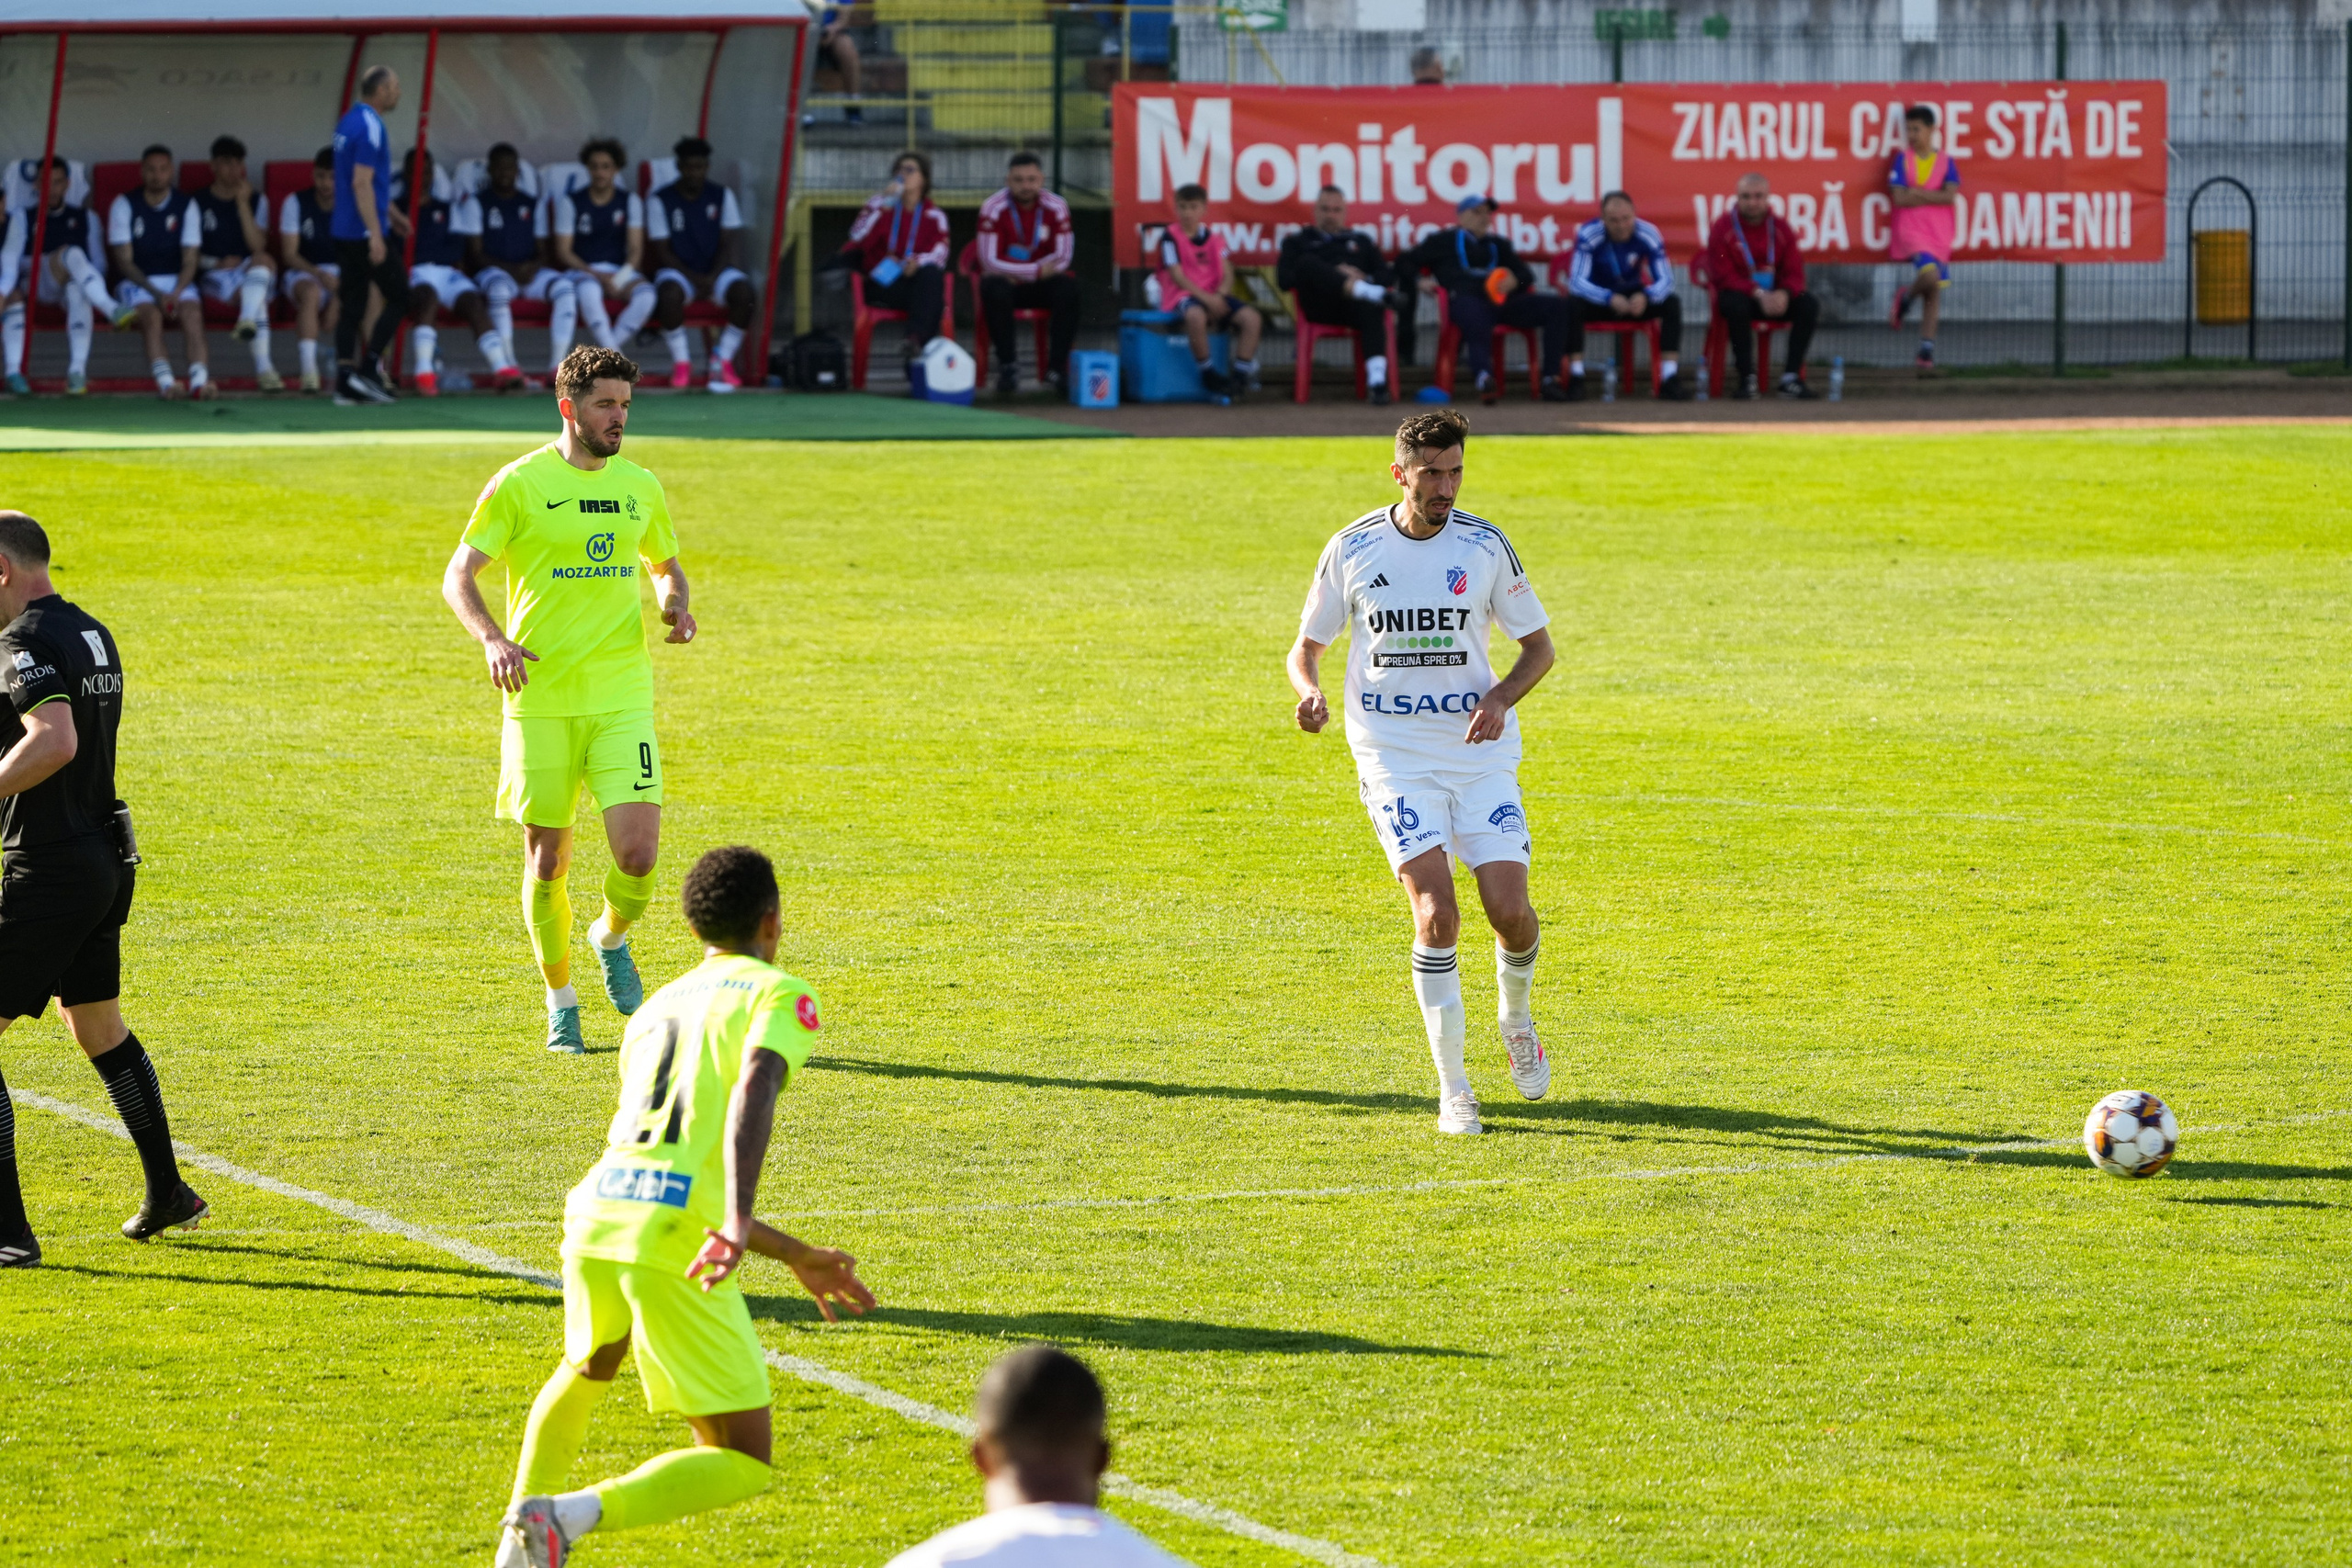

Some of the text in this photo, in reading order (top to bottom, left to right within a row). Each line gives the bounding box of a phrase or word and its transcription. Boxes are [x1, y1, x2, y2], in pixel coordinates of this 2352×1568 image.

[1672, 101, 1838, 160] ZIARUL
[1984, 89, 2073, 160] STĂ
[2086, 100, 2143, 158] DE
[1136, 96, 1623, 203] Monitorul
[1693, 181, 1850, 251] VBĂ
[1345, 536, 1384, 559] ELECTROALFA
[1456, 535, 1496, 558] ELECTROALFA
[552, 567, 617, 579] MOZZART
[1368, 608, 1471, 634] UNIBET
[1423, 655, 1448, 665] SPRE
[1449, 654, 1463, 665] 0%
[9, 664, 56, 693] NORDIS
[1362, 693, 1481, 715] ELSACO
[639, 742, 652, 778] 9
[1383, 795, 1419, 838] 16
[1491, 810, 1503, 823] FIVE
